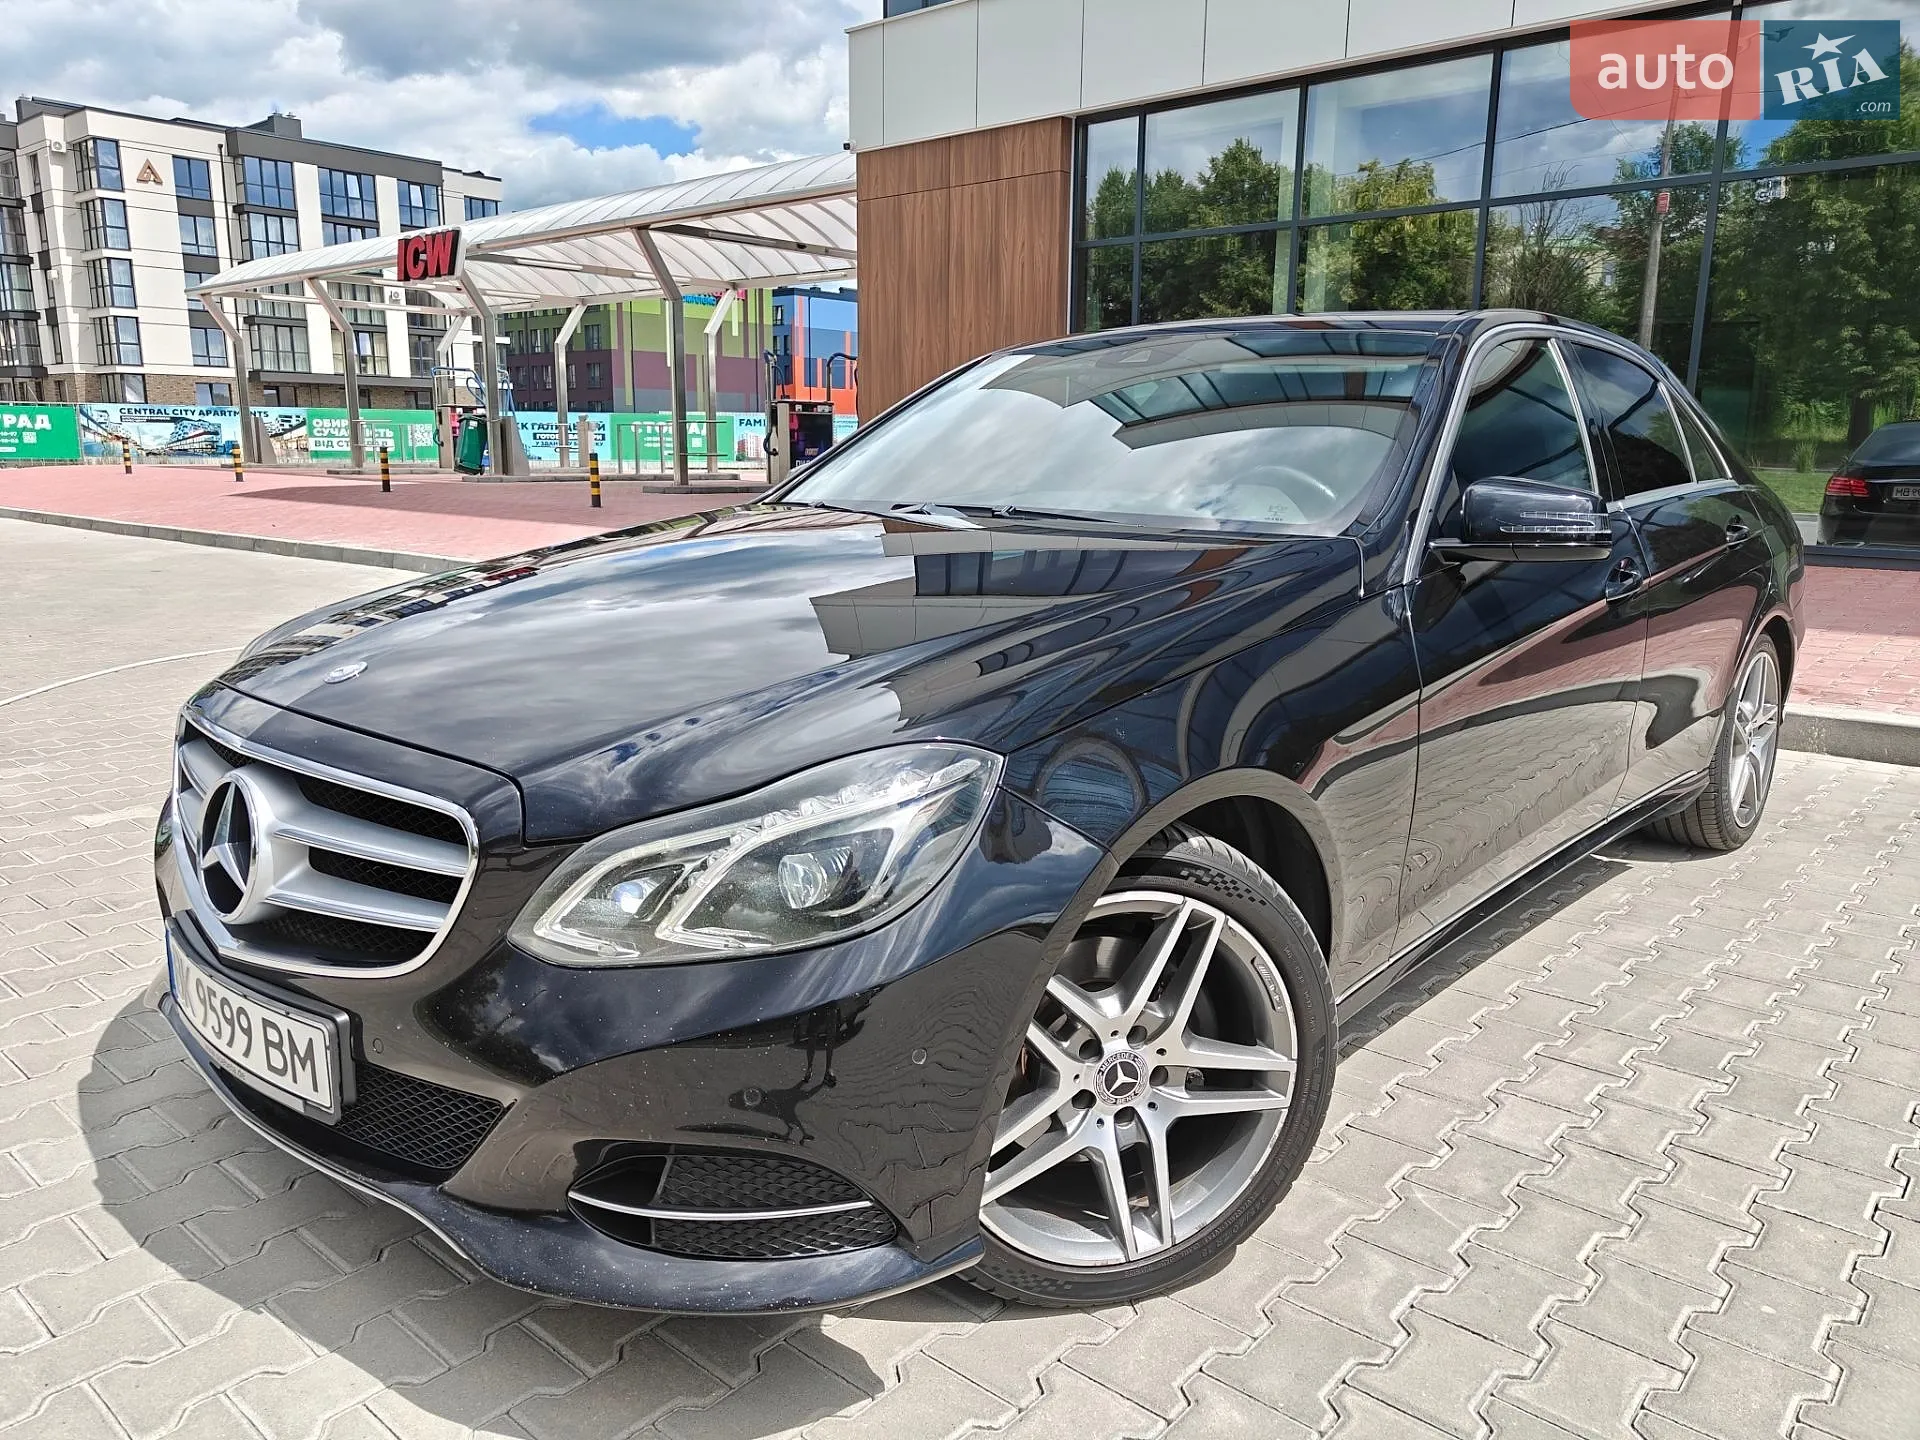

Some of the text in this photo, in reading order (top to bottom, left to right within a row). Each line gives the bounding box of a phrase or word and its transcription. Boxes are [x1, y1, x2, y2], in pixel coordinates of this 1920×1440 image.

[397, 230, 459, 281] ICW
[119, 407, 269, 418] CENTRAL CITY APARTMNTS
[0, 413, 52, 431] РАД
[739, 418, 766, 427] FAMI
[196, 978, 253, 1058] 9599
[262, 1017, 319, 1093] BM
